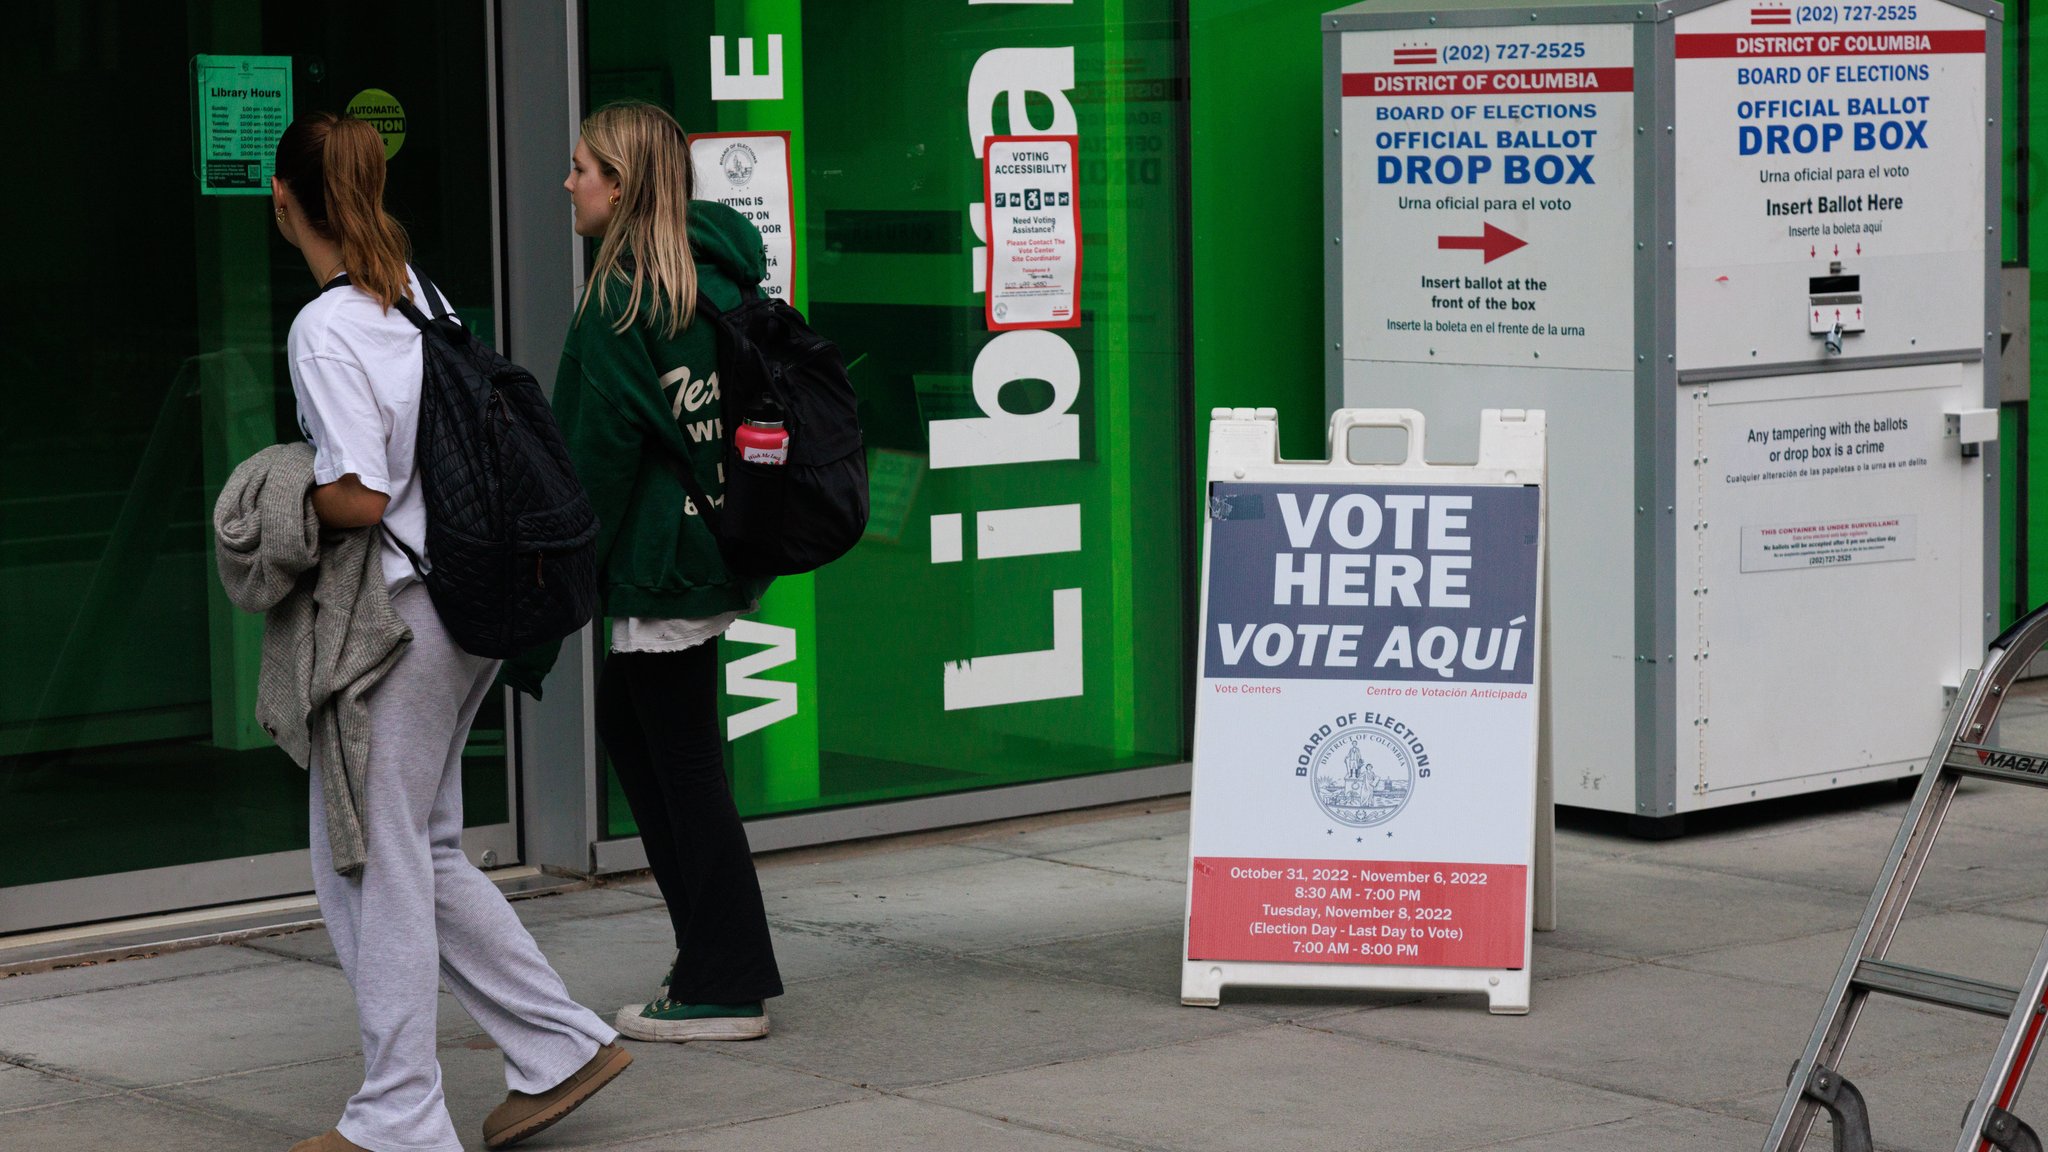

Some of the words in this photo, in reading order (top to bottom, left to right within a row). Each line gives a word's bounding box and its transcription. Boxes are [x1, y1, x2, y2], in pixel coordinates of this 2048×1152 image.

[1796, 6, 1838, 24] (202)
[1843, 5, 1916, 20] 727-2525
[1442, 44, 1489, 64] (202)
[1496, 42, 1585, 59] 727-2525
[1736, 36, 1814, 53] DISTRICT
[1818, 36, 1840, 52] OF
[1844, 35, 1931, 51] COLUMBIA
[1374, 74, 1457, 91] DISTRICT
[1462, 74, 1488, 90] OF
[1492, 72, 1598, 89] COLUMBIA
[1738, 67, 1801, 84] BOARD
[1807, 66, 1830, 83] OF
[1836, 64, 1929, 82] ELECTIONS
[211, 87, 247, 99] Library
[250, 88, 281, 97] Hours
[350, 105, 400, 114] AUTOMATIC
[1376, 106, 1444, 120] BOARD
[1450, 105, 1476, 119] OF
[1484, 103, 1596, 119] ELECTIONS
[1737, 98, 1840, 119] OFFICIAL
[1847, 96, 1929, 115] BALLOT
[372, 119, 403, 131] TION
[1376, 131, 1487, 149] OFFICIAL
[1496, 130, 1597, 148] BALLOT
[1739, 122, 1843, 155] DROP
[1854, 120, 1927, 151] BOX
[1012, 152, 1049, 161] VOTING
[994, 164, 1067, 174] ACCESSIBILITY
[1377, 154, 1491, 184] DROP
[1504, 154, 1594, 184] BOX
[1760, 169, 1789, 183] Urna
[1794, 167, 1832, 181] oficial
[1836, 168, 1864, 182] para
[1868, 165, 1879, 178] el
[1883, 165, 1909, 177] voto
[754, 196, 763, 206] IS
[1398, 196, 1430, 209] Urna
[1435, 196, 1478, 209] oficial
[1484, 199, 1516, 212] para
[1522, 196, 1534, 210] el
[1539, 197, 1571, 210] voto
[1766, 198, 1812, 216] Insert
[1818, 195, 1862, 213] Ballot
[1868, 194, 1902, 210] Here
[756, 211, 769, 220] ON
[1012, 216, 1031, 224] Need
[1033, 216, 1056, 226] Voting
[758, 224, 782, 234] LOOR
[1012, 225, 1055, 234] Assistance?
[1788, 225, 1819, 237] Inserte
[1822, 223, 1830, 235] la
[1833, 222, 1860, 234] boleta
[1863, 220, 1882, 234] aquí
[1421, 275, 1460, 288] Insert
[1464, 276, 1502, 289] ballot
[1506, 278, 1520, 290] at
[1524, 277, 1546, 290] the
[1431, 295, 1463, 308] front
[1467, 296, 1480, 309] of
[1485, 297, 1506, 309] the
[1511, 297, 1535, 310] box
[1387, 318, 1421, 330] Inserte
[1423, 319, 1432, 331] la
[1435, 320, 1466, 332] boleta
[1470, 323, 1482, 332] en
[1485, 321, 1494, 333] el
[1497, 321, 1528, 334] frente
[1531, 323, 1544, 334] de
[1548, 323, 1557, 335] la
[1560, 326, 1584, 336] urna
[928, 0, 1084, 711] Liba
[1747, 428, 1769, 445] Any
[1772, 424, 1826, 442] tampering
[1829, 421, 1851, 435] with
[1854, 420, 1870, 433] the
[1873, 417, 1908, 432] ballots
[1769, 451, 1780, 462] or
[1783, 447, 1808, 462] drop
[1812, 445, 1831, 458] box
[1834, 443, 1843, 456] is
[1846, 444, 1852, 455] a
[1855, 440, 1884, 454] crime
[1726, 474, 1760, 483] Cualquier
[1762, 469, 1797, 480] alteración
[1799, 468, 1807, 476] de
[1822, 465, 1854, 476] papeletas
[1871, 462, 1886, 470] urna
[1908, 458, 1927, 466] delito
[1277, 493, 1472, 550] VOTE
[1778, 526, 1816, 534] CONTAINER
[1851, 519, 1898, 528] SURVEILLANCE
[1809, 557, 1824, 565] (202)
[1825, 554, 1852, 563] 727-2525
[1274, 552, 1472, 608] HERE
[1218, 622, 1364, 667] VOTE
[1374, 614, 1527, 678] AQUÍ
[1214, 683, 1238, 693] Vote
[1241, 684, 1281, 694] Centers
[1366, 686, 1401, 695] Centro
[1404, 687, 1418, 696] de
[1421, 687, 1467, 697] Votación
[1470, 688, 1527, 700] Anticipada
[1295, 724, 1332, 777] BOARD
[1335, 712, 1357, 727] OF
[1364, 711, 1431, 778] ELECTIONS
[1320, 737, 1353, 765] DISTRICT
[1370, 735, 1406, 767] COLUMBIA
[1230, 866, 1283, 879] October
[1286, 868, 1308, 882] 31,
[1312, 868, 1348, 880] 2022
[1360, 869, 1430, 882] November
[1433, 871, 1446, 885] 6,
[1450, 871, 1487, 884] 2022
[1294, 886, 1326, 899] 8:30
[1329, 887, 1351, 899] AM
[1364, 888, 1394, 900] 7:00
[1399, 889, 1420, 901] PM
[1262, 903, 1320, 919] Tuesday,
[1325, 905, 1394, 918] November
[1398, 907, 1410, 921] 8,
[1415, 907, 1452, 920] 2022
[1249, 921, 1307, 935] (Election
[1311, 923, 1337, 937] Day
[1348, 924, 1376, 936] Last
[1381, 925, 1406, 940] Day
[1410, 926, 1424, 937] to
[1428, 926, 1462, 941] Vote)
[1292, 940, 1323, 953] 7:00
[1326, 942, 1349, 954] AM
[1360, 942, 1392, 955] 8:00
[1396, 944, 1418, 955] PM
